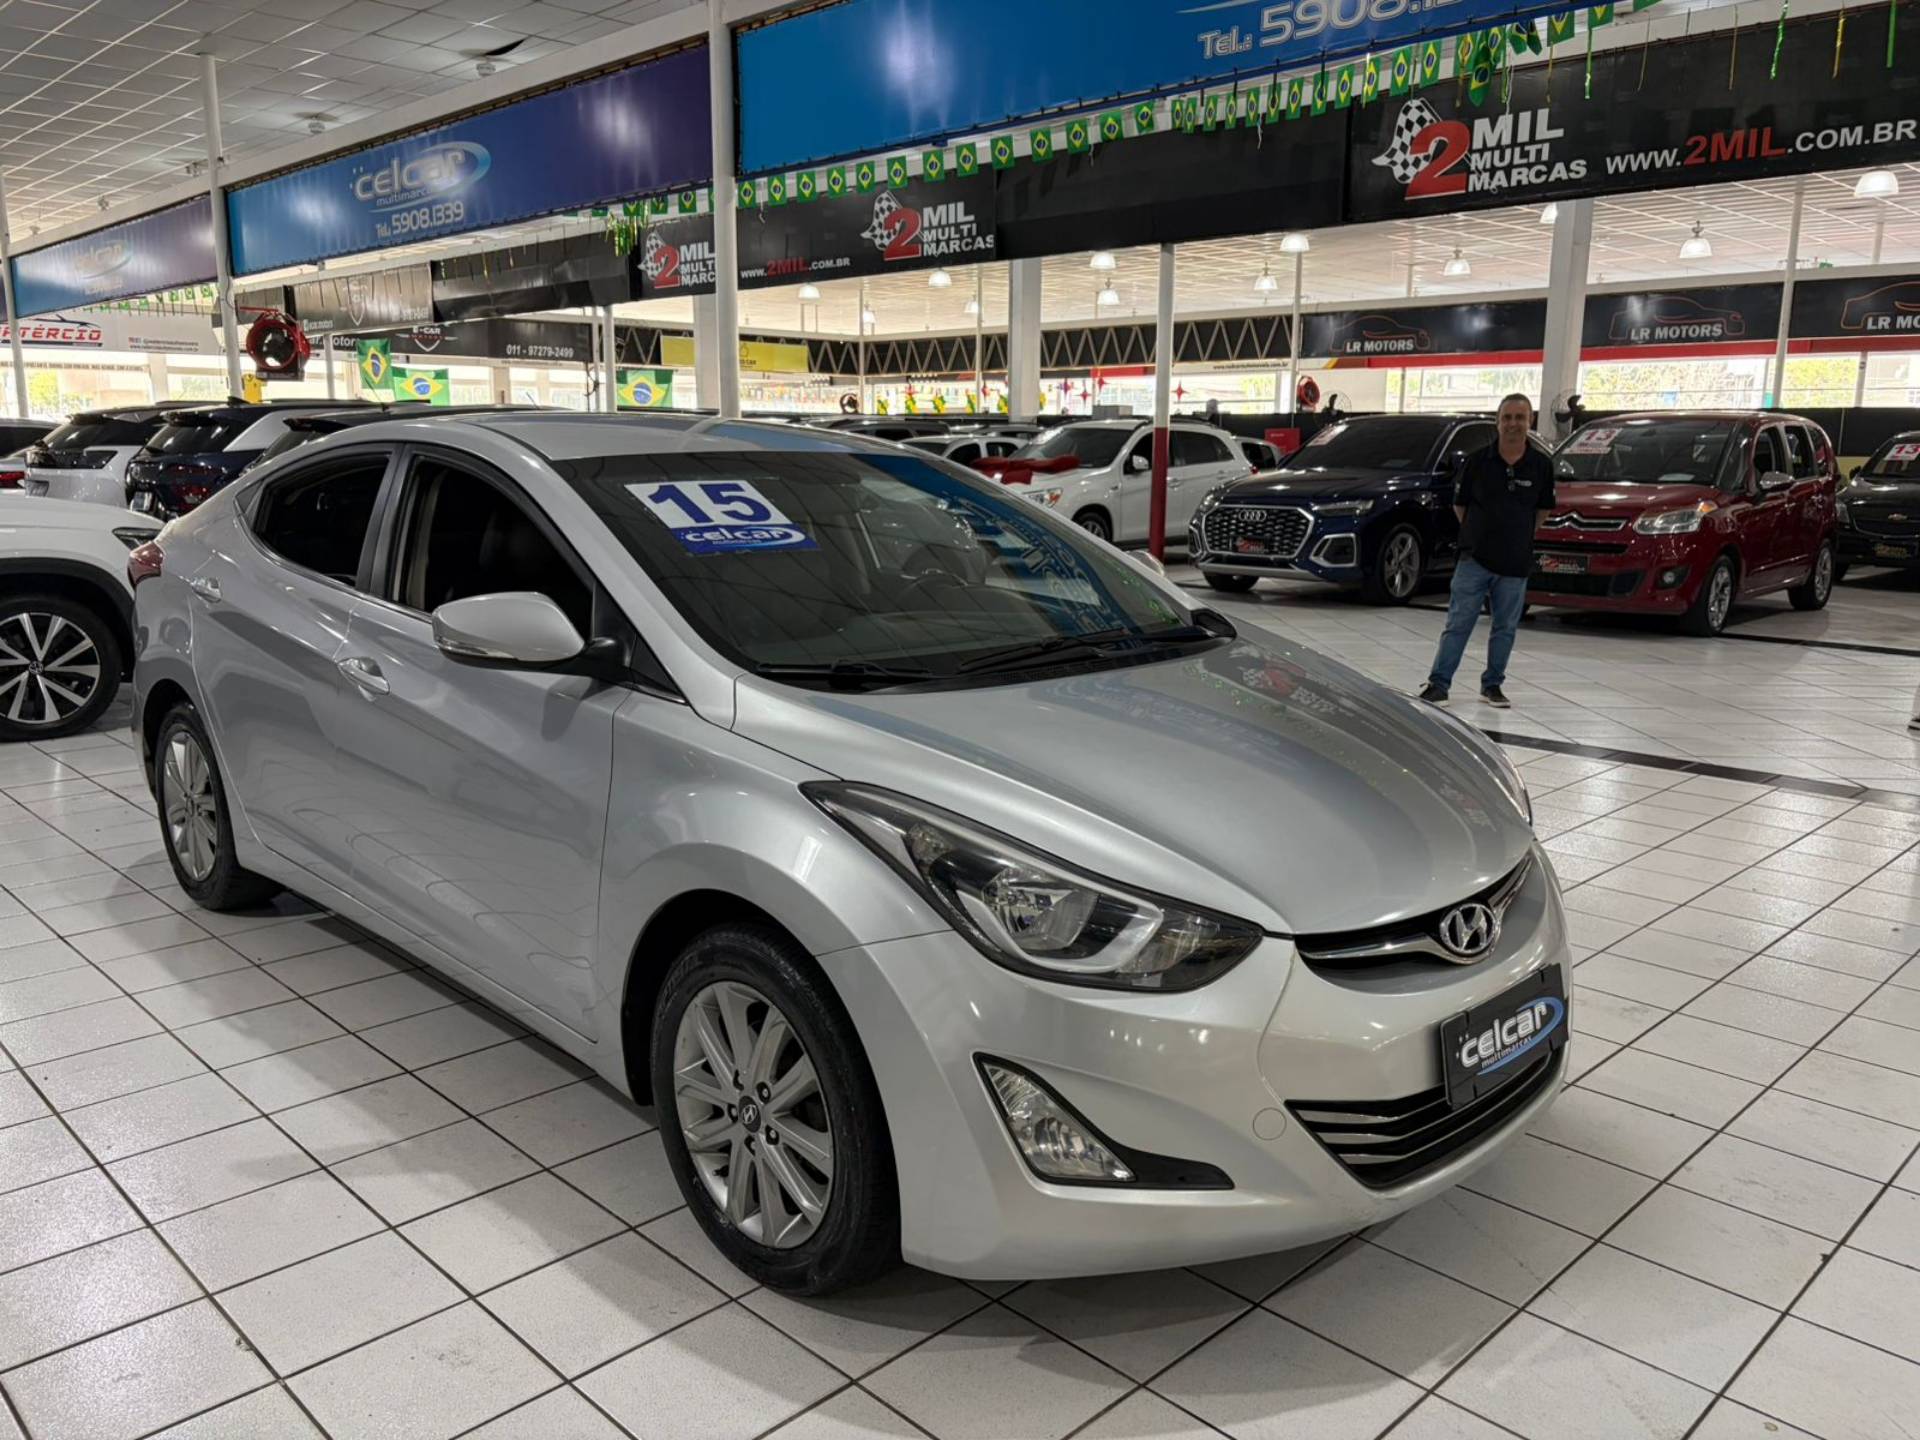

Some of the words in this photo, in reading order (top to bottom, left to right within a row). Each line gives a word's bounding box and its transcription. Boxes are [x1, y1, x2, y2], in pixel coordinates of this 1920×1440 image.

[1198, 25, 1253, 59] Tel.:
[1260, 0, 1462, 47] 590.
[1405, 119, 1470, 201] 2
[1472, 108, 1565, 149] MIL
[1470, 143, 1550, 171] MULTI
[1468, 159, 1588, 193] MARCAS
[376, 187, 432, 207] multimarc
[391, 200, 465, 235] 5908.1339
[884, 207, 922, 261] 2
[923, 201, 975, 227] MIL
[923, 223, 977, 242] MULTI
[923, 234, 995, 257] MARCAS
[654, 245, 680, 288] 2
[680, 241, 716, 262] MIL
[1630, 328, 1650, 341] LR
[1654, 324, 1723, 340] MOTORS
[1867, 315, 1891, 330] LR
[1347, 340, 1361, 353] LR
[1364, 339, 1414, 352] MOTORS
[648, 483, 772, 524] 15
[685, 527, 785, 542] celcar
[1461, 1001, 1548, 1068] celcar
